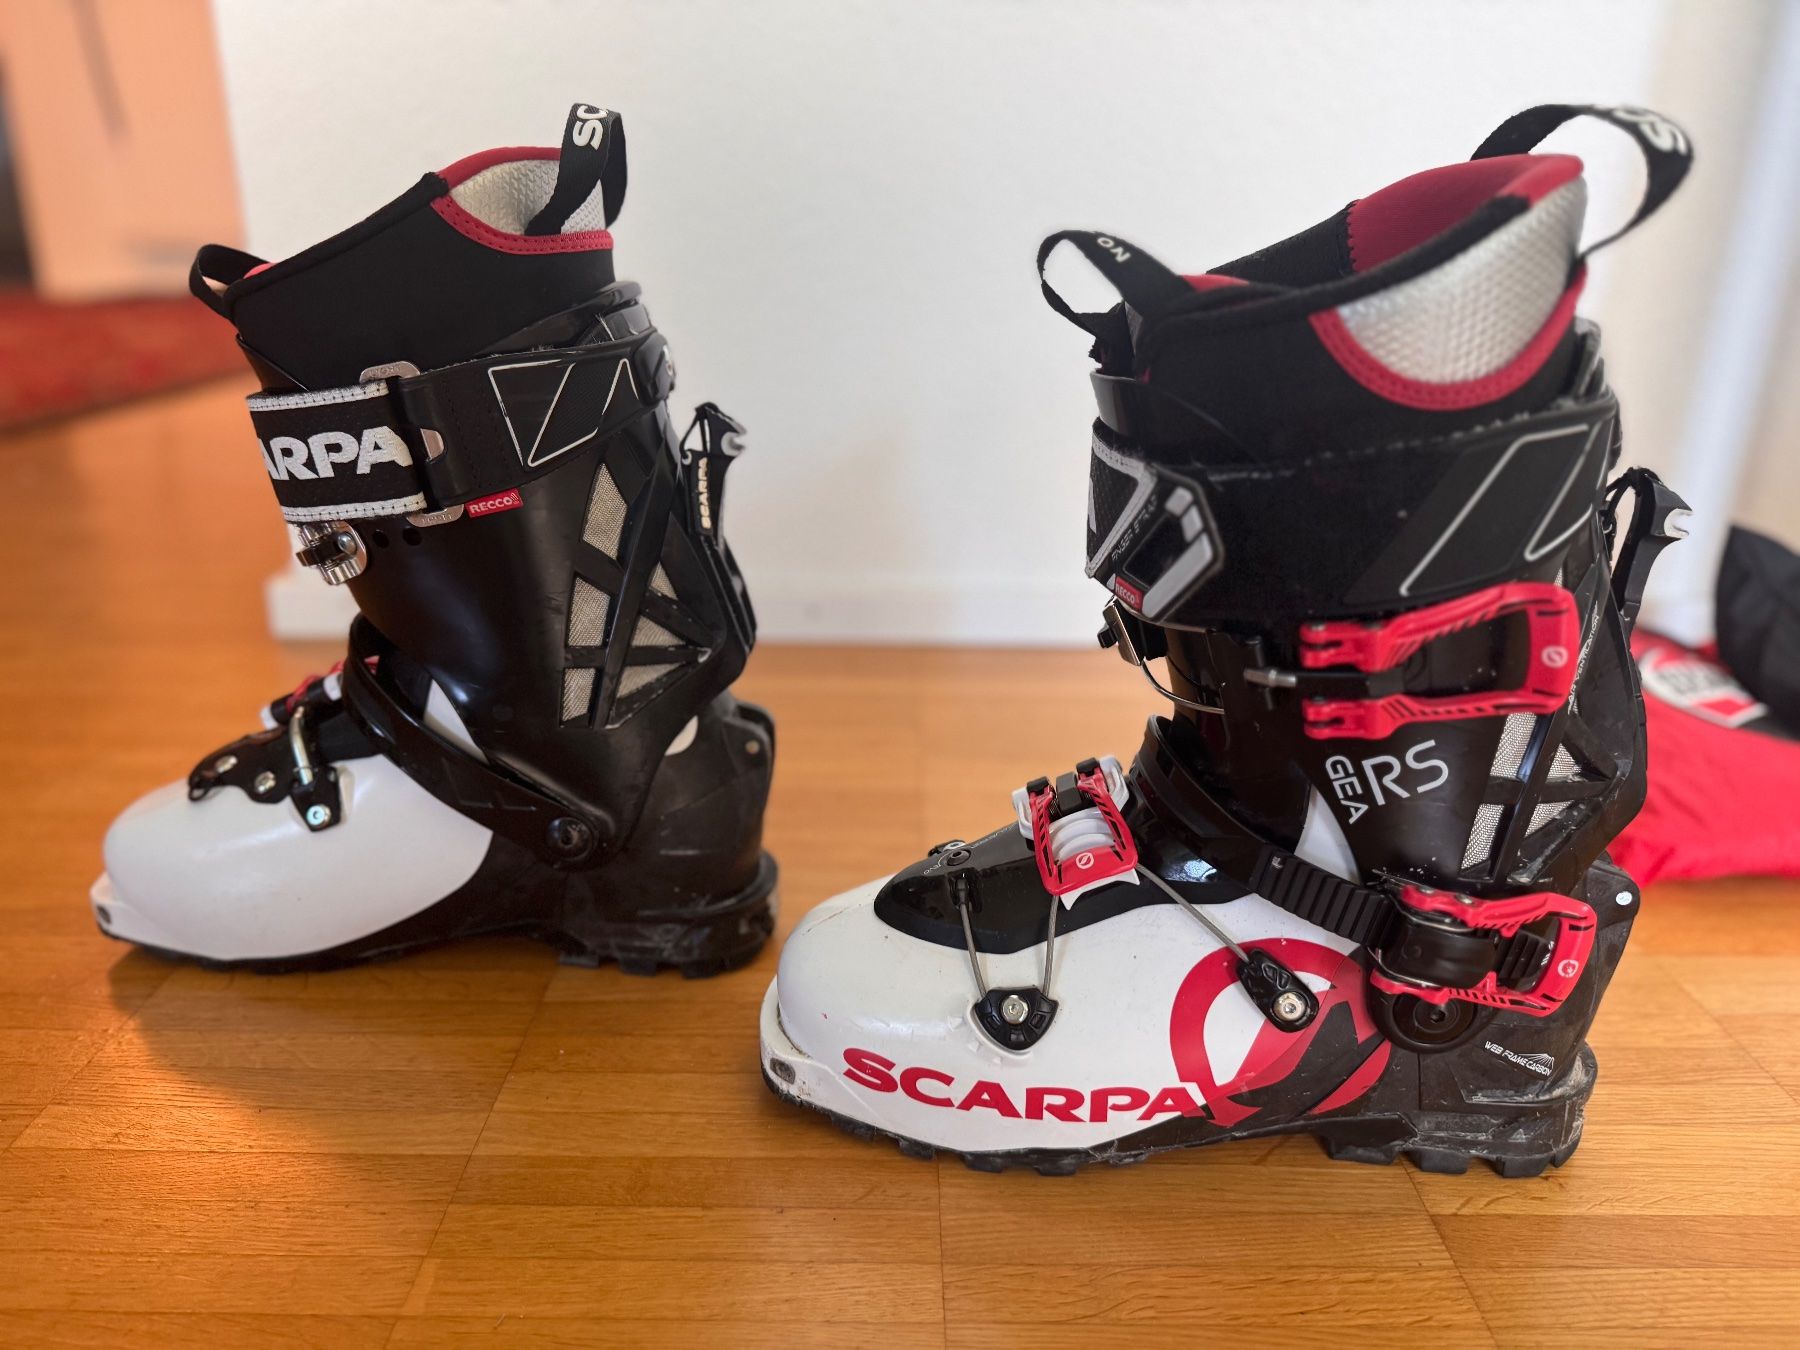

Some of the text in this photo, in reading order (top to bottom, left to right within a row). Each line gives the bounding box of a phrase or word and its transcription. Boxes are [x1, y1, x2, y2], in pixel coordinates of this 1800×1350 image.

[470, 496, 513, 514] RECCO
[698, 456, 711, 529] SCARPA
[1115, 584, 1136, 604] RECCO
[1574, 614, 1599, 681] VENTILATION
[1325, 755, 1369, 825] GEA
[1361, 739, 1449, 806] RS
[842, 1047, 1207, 1123] SCARPA
[1484, 1040, 1553, 1077] WEB FRAME CARBON
